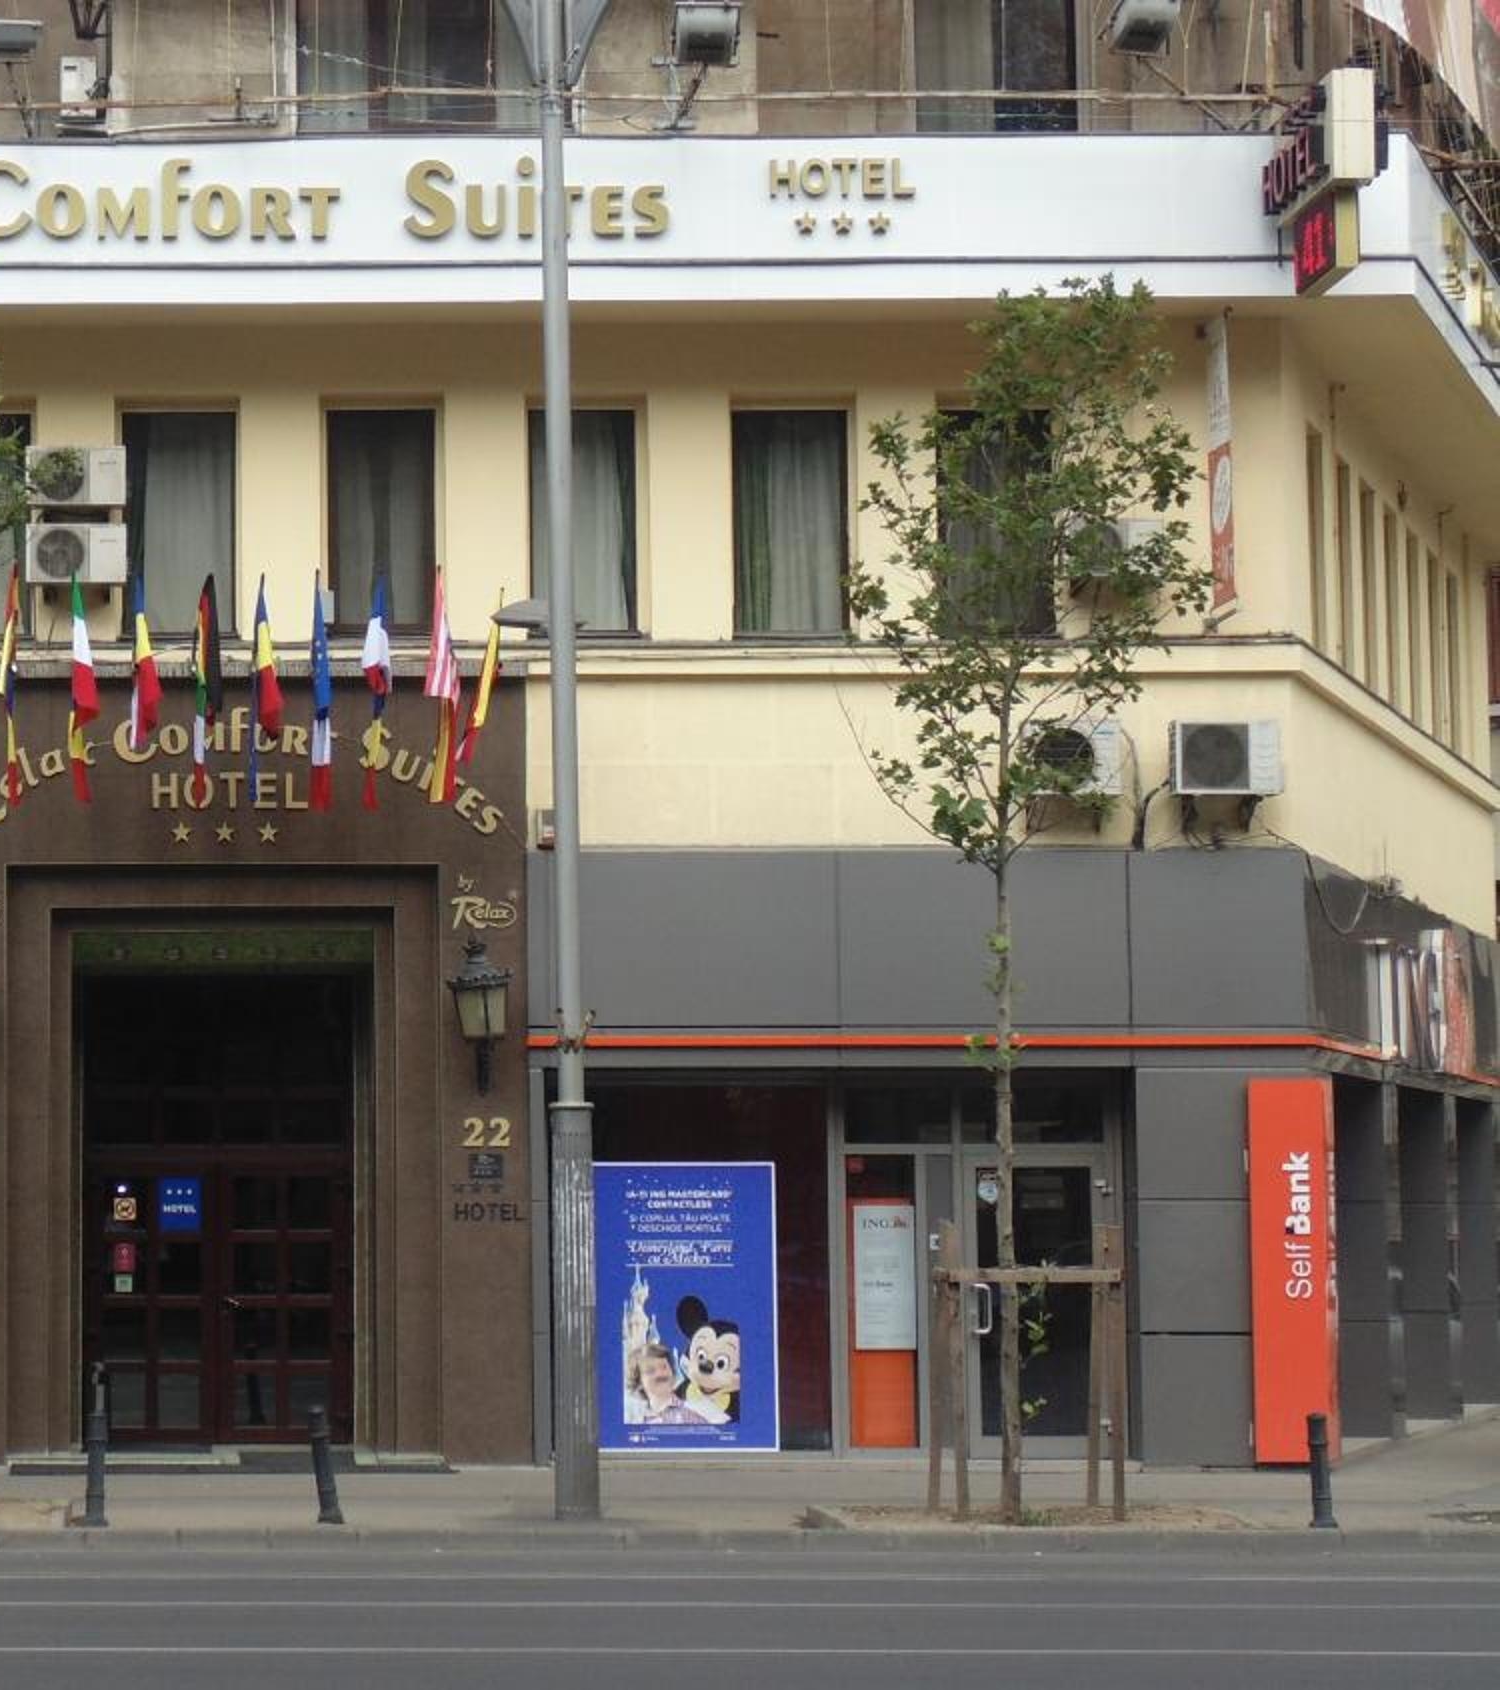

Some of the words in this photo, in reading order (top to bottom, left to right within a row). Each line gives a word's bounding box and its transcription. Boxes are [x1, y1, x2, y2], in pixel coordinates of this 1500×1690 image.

[769, 157, 917, 201] HOTEL
[1262, 126, 1318, 216] HOTEL
[151, 771, 310, 810] HOTEL
[457, 872, 477, 894] by
[451, 896, 517, 930] Relax
[462, 1117, 511, 1148] 22
[647, 1200, 712, 1209] CONTACTLESS
[1282, 1151, 1311, 1234] Bank
[163, 1203, 197, 1214] HOTEL
[454, 1202, 525, 1222] HOTEL
[700, 1214, 731, 1223] POATE
[637, 1224, 682, 1233] DESCHIDE
[862, 1216, 889, 1230] ING
[1285, 1242, 1313, 1299] Self
